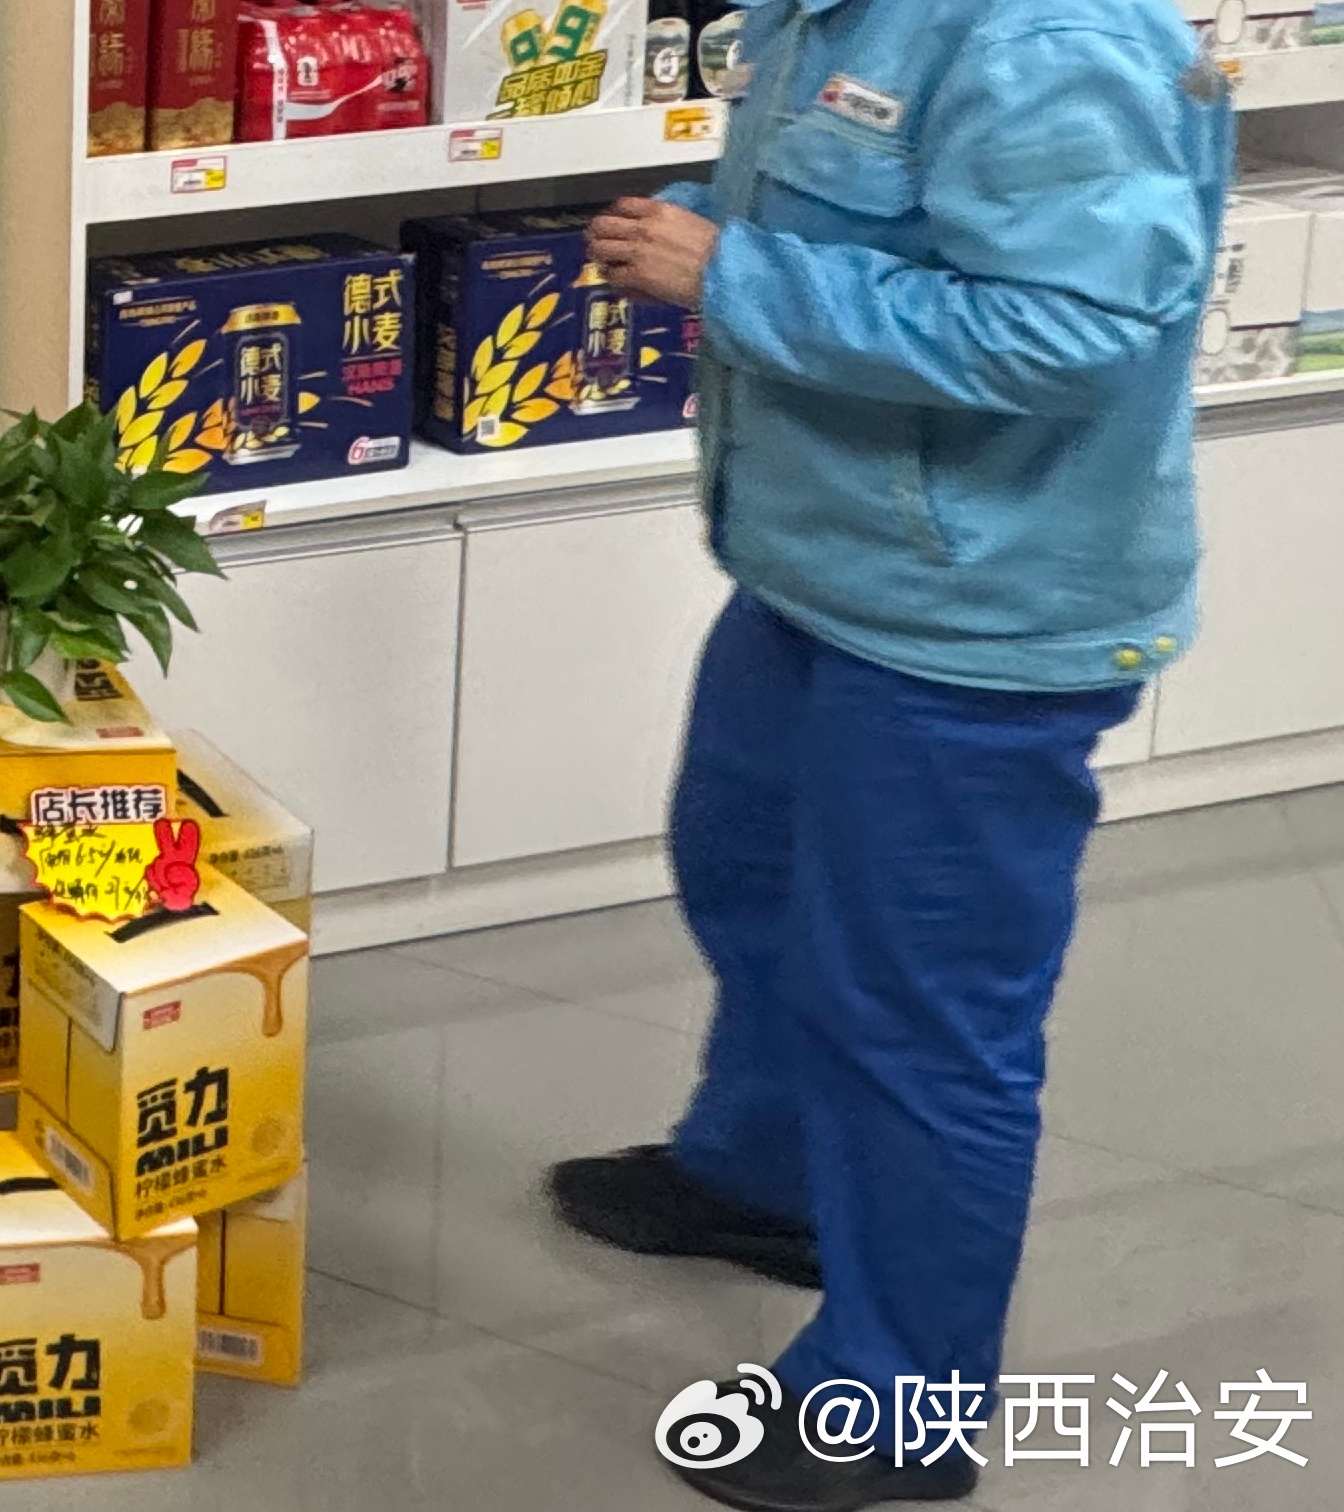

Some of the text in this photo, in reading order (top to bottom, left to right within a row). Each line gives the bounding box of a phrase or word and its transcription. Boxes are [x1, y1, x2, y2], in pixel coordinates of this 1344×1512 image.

[344, 269, 403, 315] 德式
[342, 312, 403, 354] 小麦
[240, 374, 282, 404] 小麦
[34, 788, 162, 823] 店长推荐
